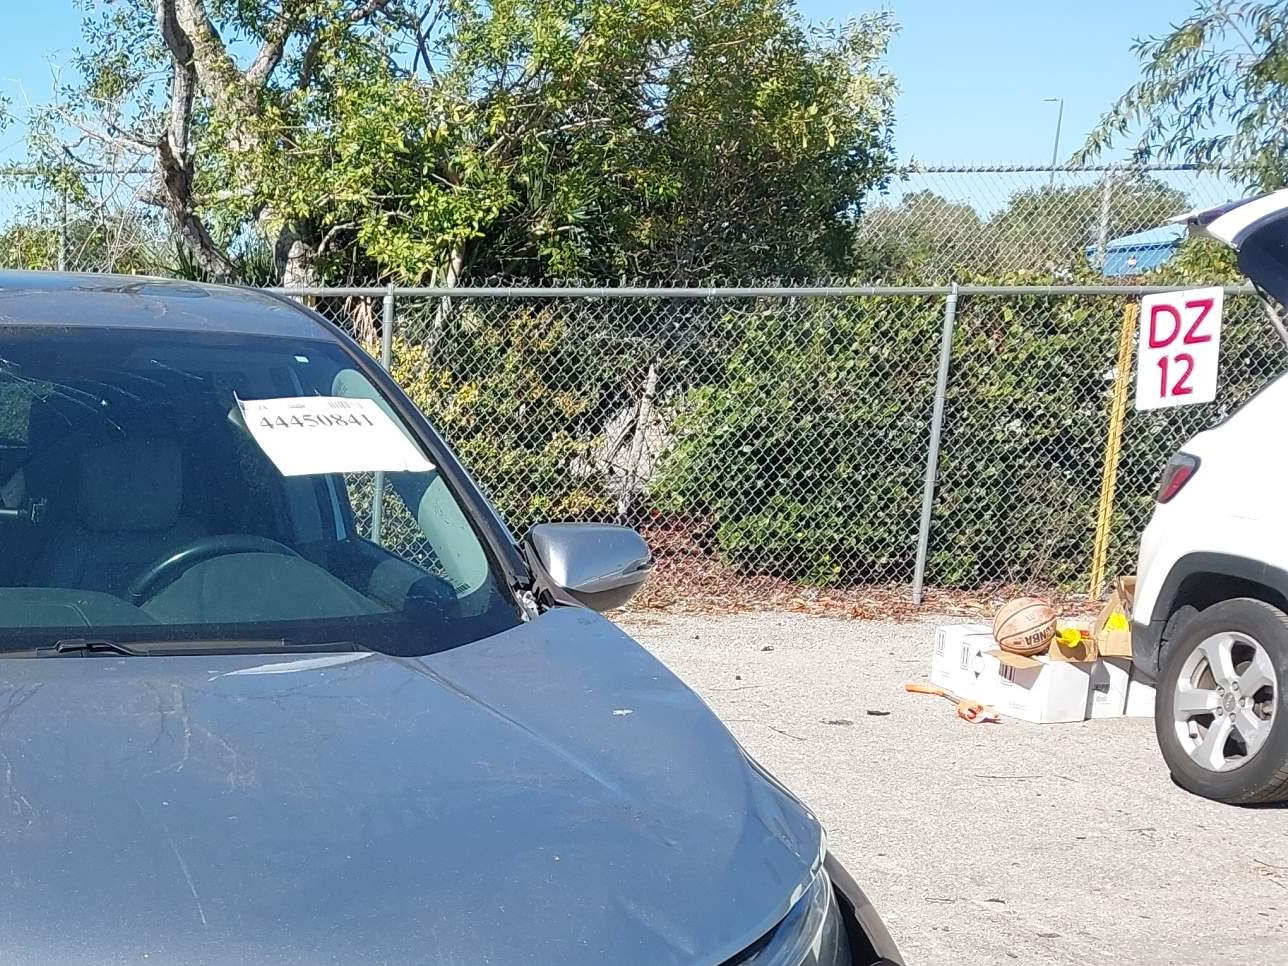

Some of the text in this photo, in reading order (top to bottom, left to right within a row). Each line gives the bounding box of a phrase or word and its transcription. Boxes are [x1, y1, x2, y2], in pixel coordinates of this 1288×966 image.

[1149, 298, 1214, 349] DZ
[1157, 353, 1193, 397] 12
[260, 413, 374, 429] 44450841
[1025, 629, 1047, 645] NBA
